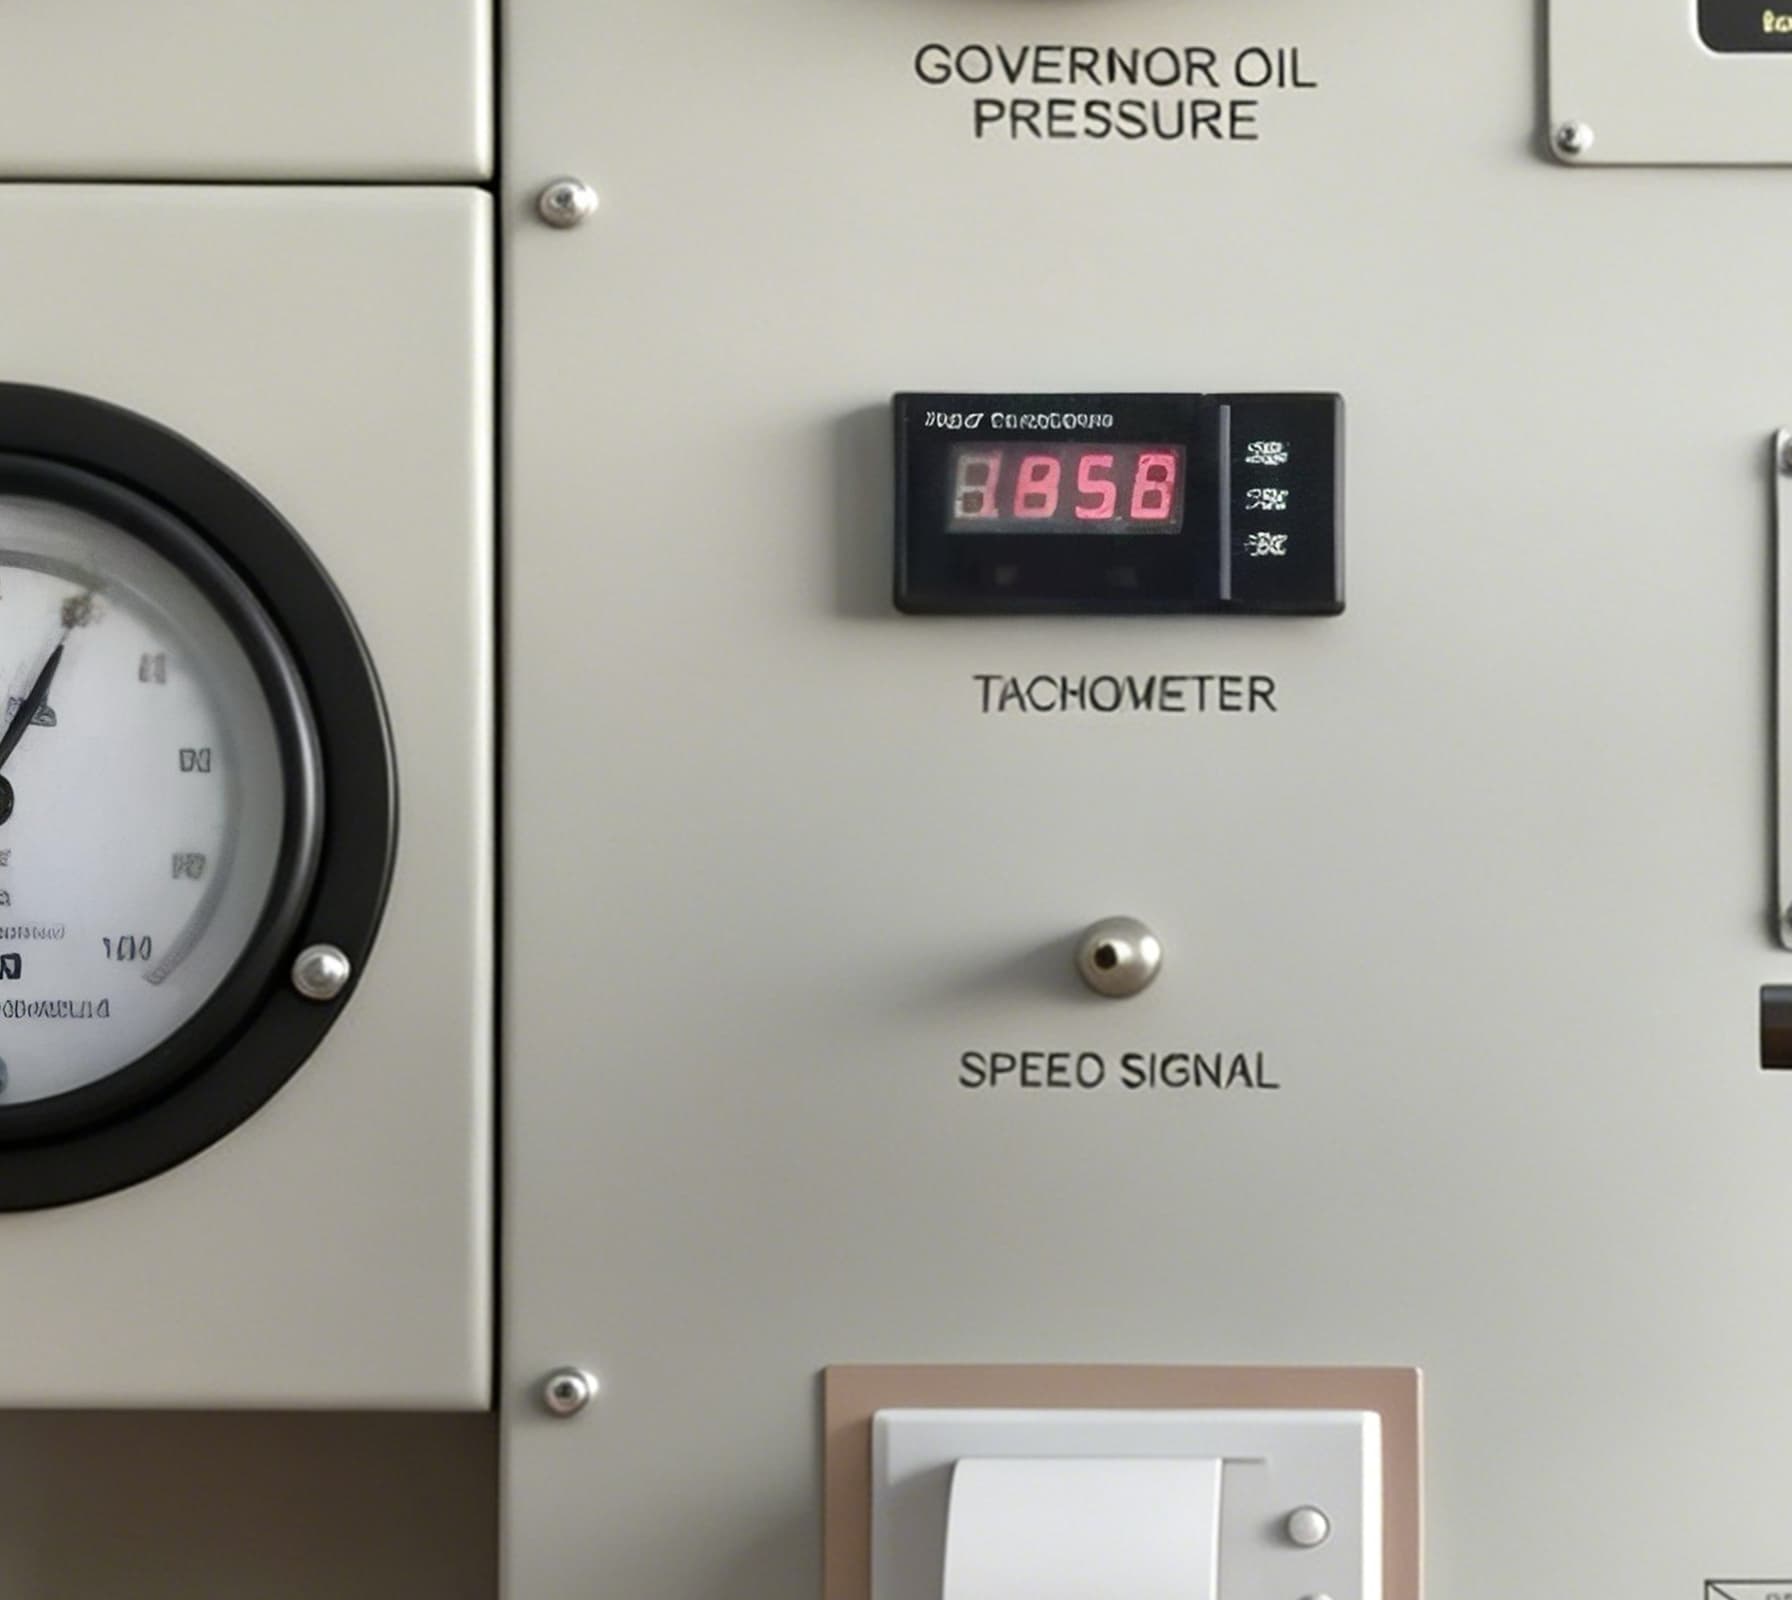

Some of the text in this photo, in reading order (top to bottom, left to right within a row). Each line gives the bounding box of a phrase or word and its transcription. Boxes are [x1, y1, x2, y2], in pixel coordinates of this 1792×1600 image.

[914, 43, 1318, 89] GOVERNOR OIL
[973, 98, 1259, 141] PRESSURE
[972, 674, 1277, 713] TACHOMETER
[1120, 1051, 1280, 1090] SIGNAL
